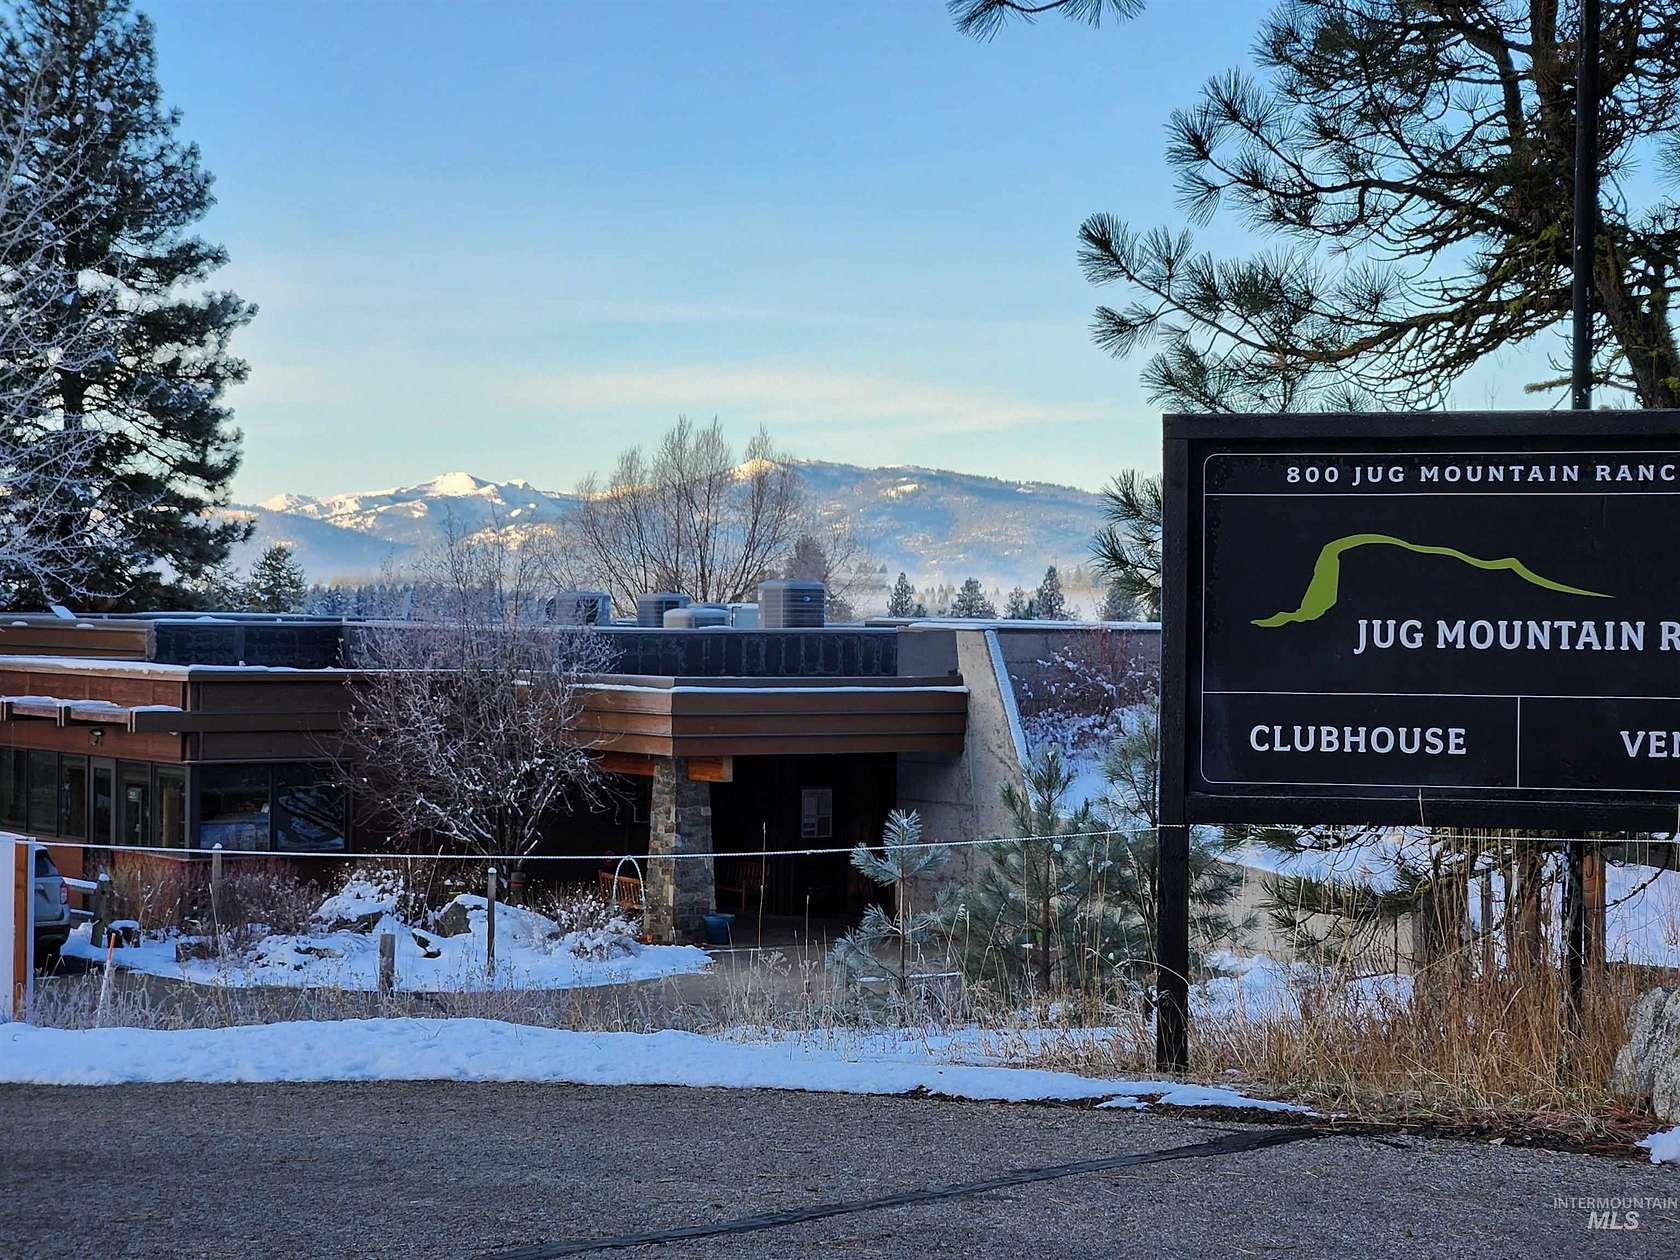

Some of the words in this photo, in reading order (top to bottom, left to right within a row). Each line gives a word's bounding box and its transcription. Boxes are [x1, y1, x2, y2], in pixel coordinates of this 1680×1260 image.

[1286, 466, 1339, 483] 800
[1351, 465, 1405, 487] JUG
[1419, 465, 1579, 482] MOUNTAIN
[1595, 464, 1676, 482] RANC
[1353, 619, 1424, 655] JUG
[1436, 619, 1646, 651] MOUNTAIN
[1249, 724, 1467, 755] CLUBHOUSE
